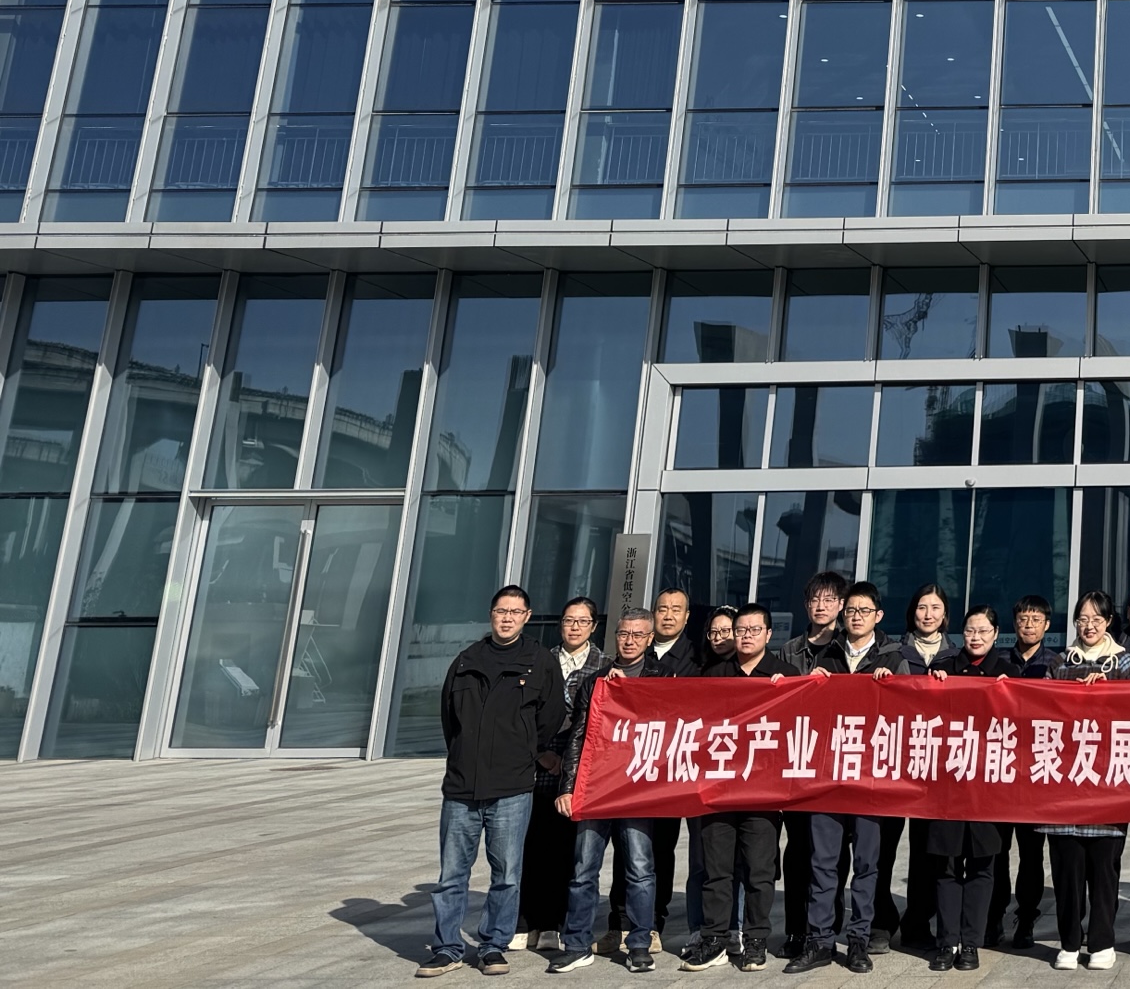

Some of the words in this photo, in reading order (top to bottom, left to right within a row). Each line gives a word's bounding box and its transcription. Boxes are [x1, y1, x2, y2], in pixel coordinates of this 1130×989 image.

[830, 714, 1017, 784] 悟创新动能
